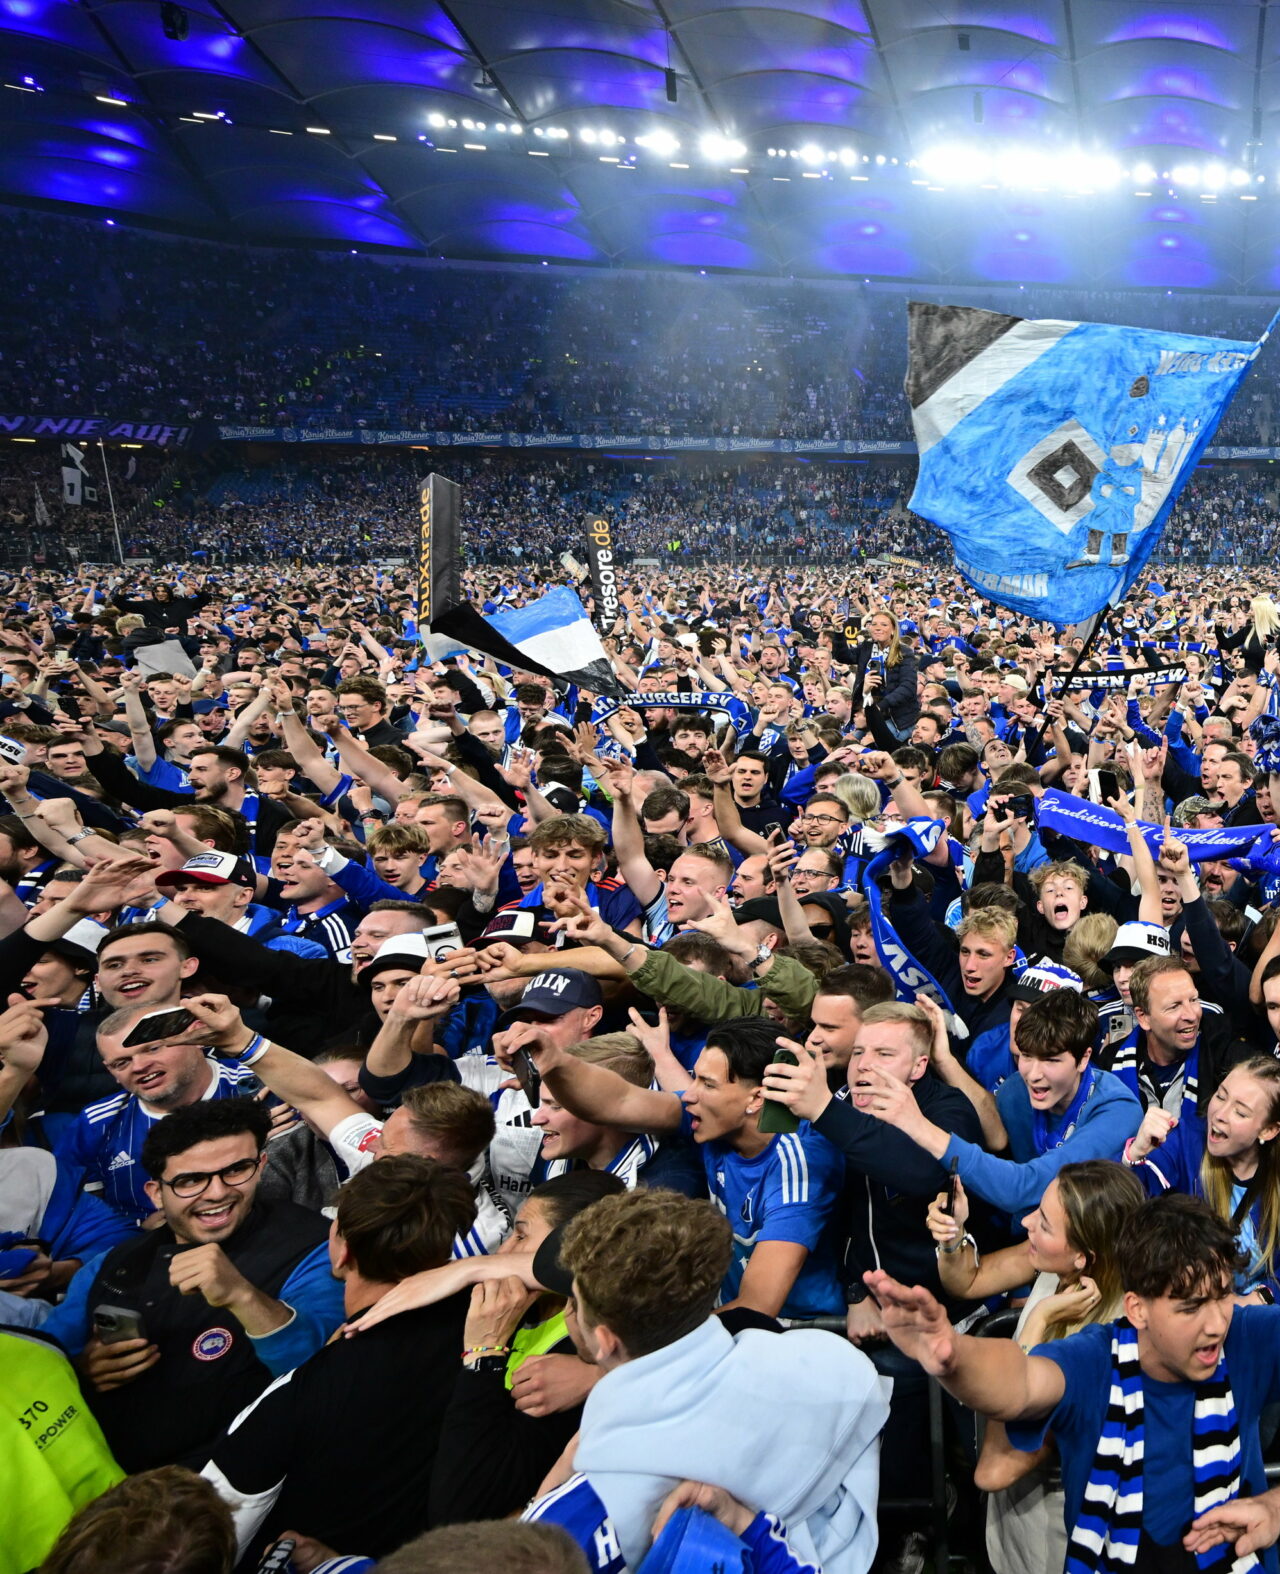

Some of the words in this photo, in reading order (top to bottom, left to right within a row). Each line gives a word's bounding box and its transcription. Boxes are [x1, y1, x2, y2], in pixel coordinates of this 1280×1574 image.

[34, 417, 104, 436] NIE
[109, 423, 191, 447] AUF!
[419, 487, 431, 620] buxtrade
[1040, 675, 1125, 690] OLSTEN
[707, 693, 732, 707] SV
[1147, 934, 1170, 951] HSV
[108, 1158, 136, 1171] adidas
[38, 1405, 78, 1445] POWER
